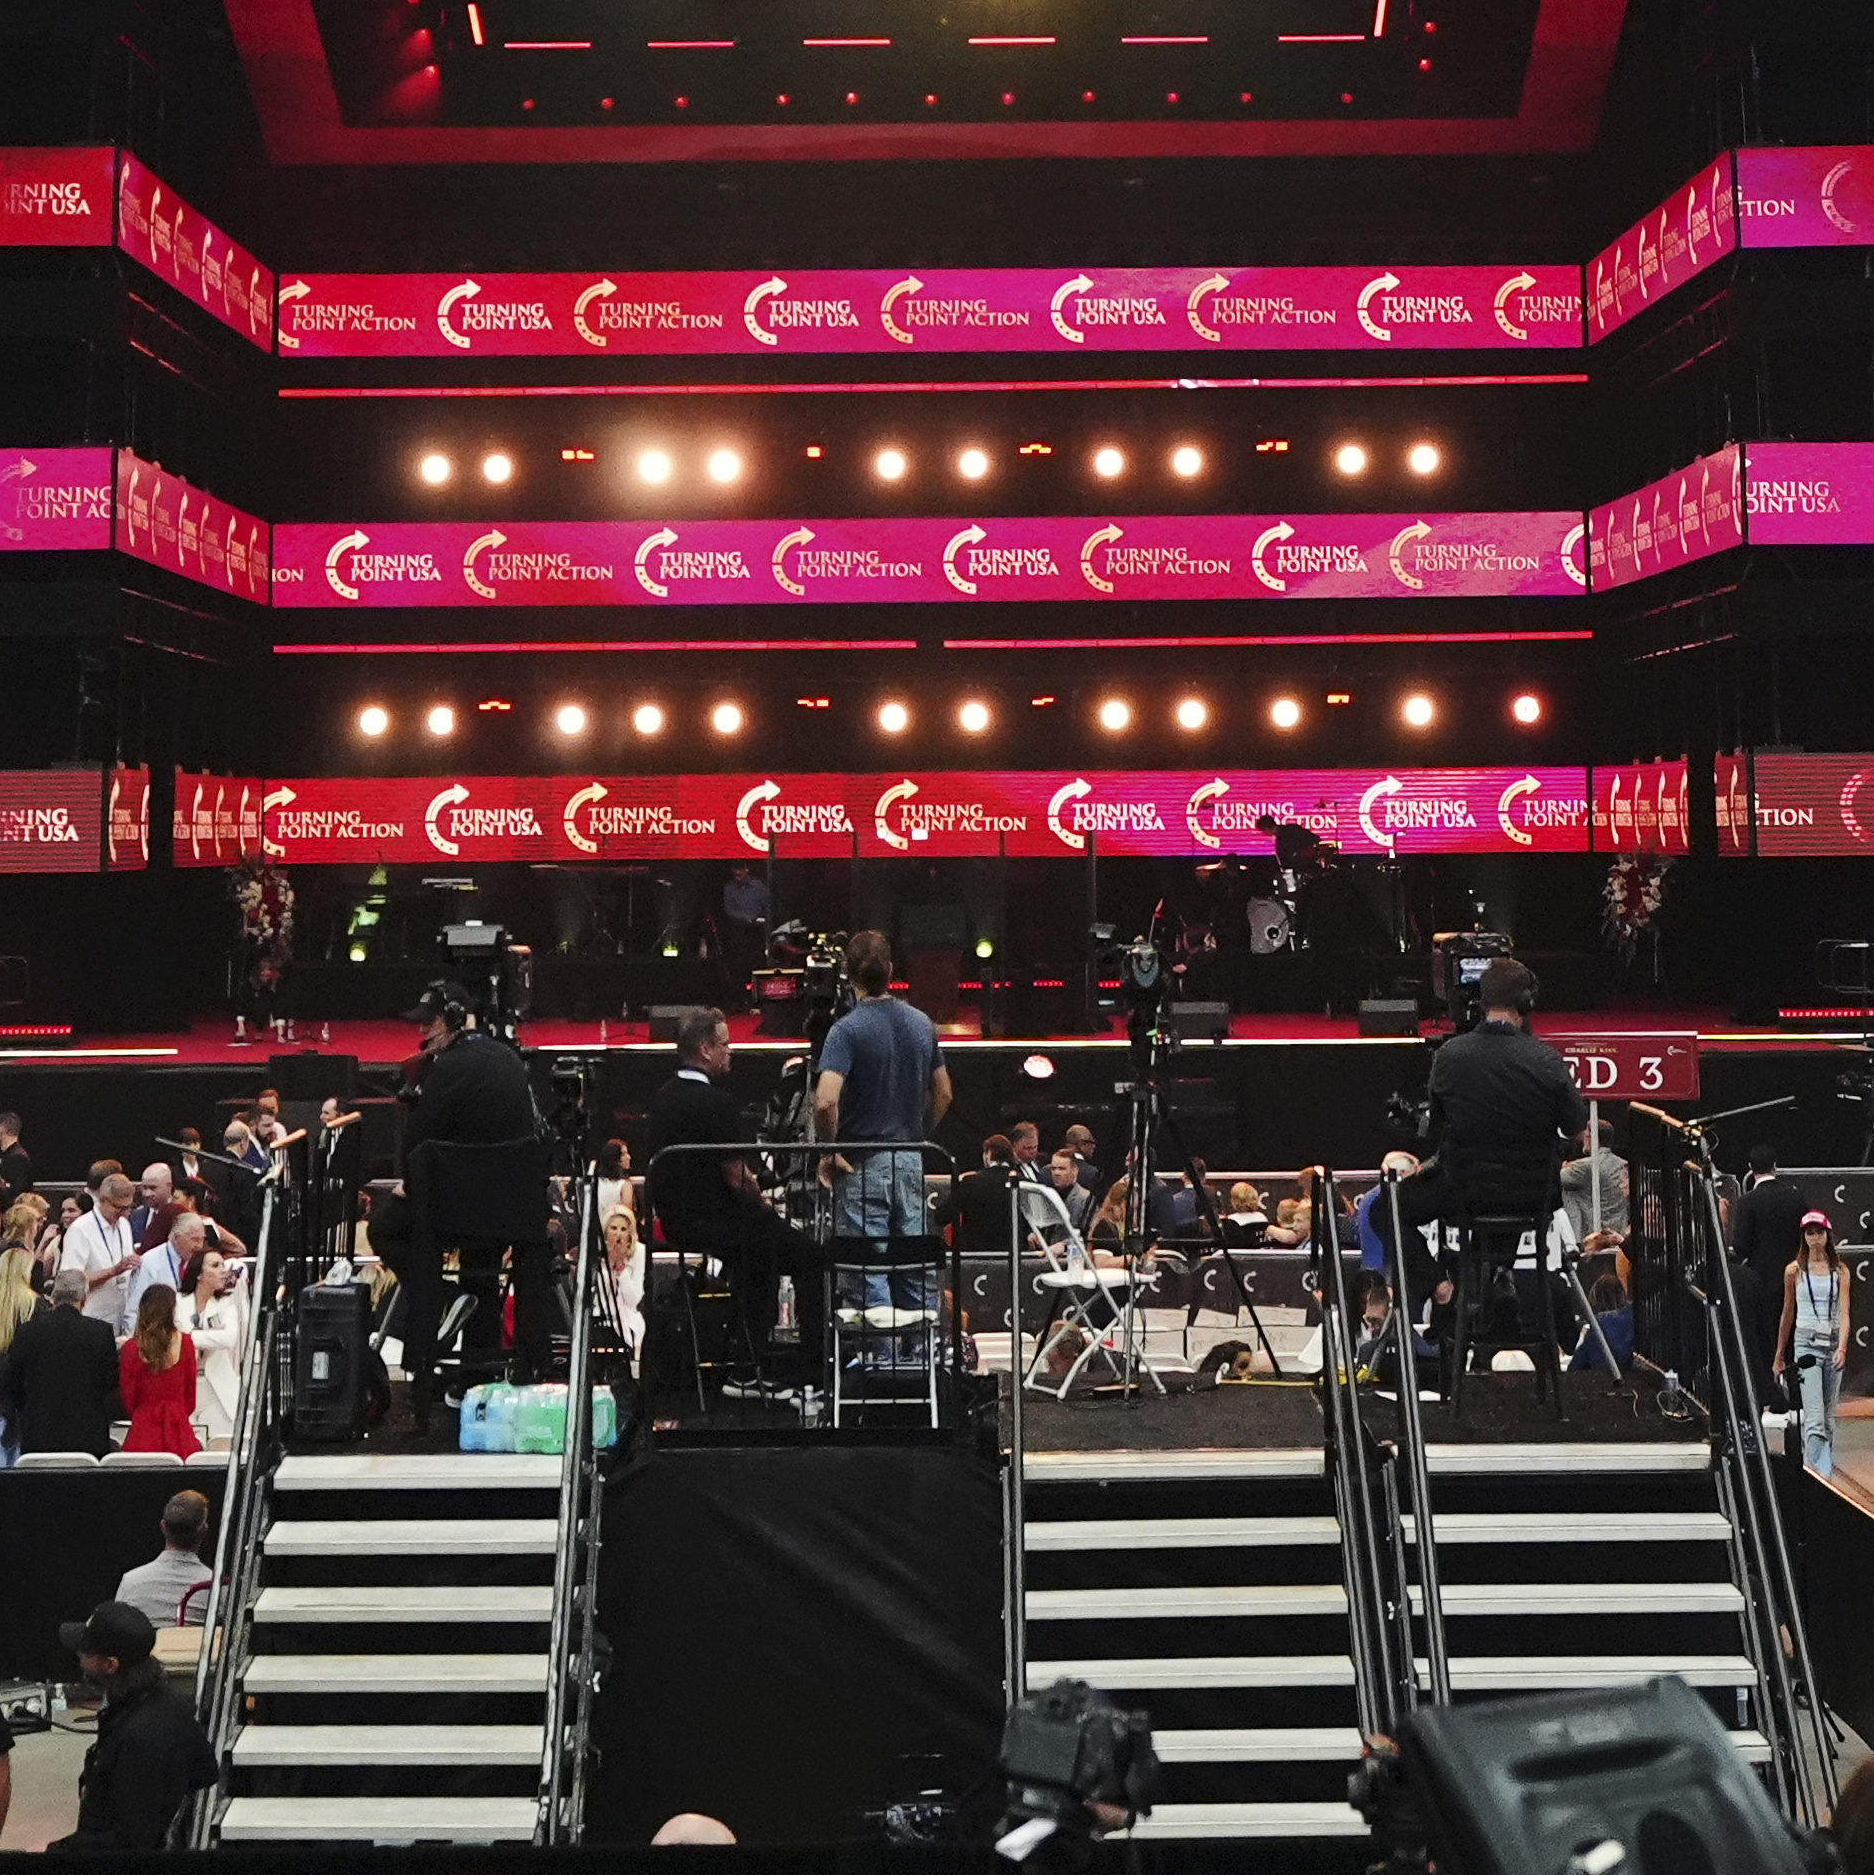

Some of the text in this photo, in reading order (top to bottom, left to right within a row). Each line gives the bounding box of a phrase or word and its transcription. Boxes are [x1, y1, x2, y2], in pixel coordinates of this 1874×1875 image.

[9, 183, 81, 199] RNING
[51, 199, 92, 216] USA
[1739, 200, 1795, 217] TION
[599, 302, 681, 316] TURNING
[769, 300, 850, 313] TURNING
[905, 299, 987, 313] TURNING
[1075, 298, 1157, 311] TURNING
[1213, 298, 1293, 311] TURNING
[1382, 296, 1464, 309] TURNING
[1517, 296, 1582, 309] TURNIN
[292, 304, 374, 318] TURNING
[462, 303, 544, 317] TURNING
[1213, 310, 1336, 324] POINT ACTION
[1382, 309, 1472, 323] POINT USA
[1519, 309, 1573, 322] POINT
[292, 316, 416, 331] POINT ACTION
[462, 316, 553, 330] POINT USA
[599, 315, 722, 328] POINT ACTION
[769, 313, 859, 327] POINT USA
[906, 312, 1029, 326] POINT ACTION
[1075, 311, 1166, 325] POINT USA
[1746, 481, 1830, 497] URNING
[15, 503, 83, 519] POINT
[1747, 497, 1798, 514] OINT
[1802, 497, 1842, 513] USA
[968, 550, 1050, 563] TURNING
[1105, 548, 1187, 561] TURNING
[1277, 546, 1359, 560] TURNING
[1414, 544, 1497, 557] TURNING
[350, 555, 433, 568] TURNING
[488, 554, 570, 567] TURNING
[660, 552, 742, 565] TURNING
[797, 551, 879, 565] TURNING
[1415, 556, 1539, 571] POINT ACTION
[660, 564, 750, 578] POINT USA
[798, 564, 921, 578] POINT ACTION
[968, 562, 1059, 576] POINT USA
[1106, 560, 1230, 575] POINT ACTION
[1277, 558, 1368, 573] POINT USA
[272, 568, 304, 582] ION
[351, 567, 442, 582] POINT USA
[488, 566, 613, 580] POINT ACTION
[761, 806, 844, 819] TURNING
[899, 805, 983, 817] TURNING
[1072, 803, 1156, 817] TURNING
[1213, 802, 1295, 816] TURNING
[1384, 801, 1467, 814] TURNING
[1522, 800, 1588, 813] TURNIN
[277, 811, 360, 825] TURNING
[450, 809, 533, 823] TURNING
[588, 807, 672, 821] TURNING
[1385, 813, 1477, 828] POINT USA
[1524, 812, 1579, 827] POINT
[1758, 808, 1814, 826] TION
[451, 821, 542, 836] POINT USA
[589, 820, 715, 834] POINT ACTION
[762, 818, 854, 833] POINT USA
[900, 817, 1026, 831] POINT ACTION
[1073, 816, 1165, 830] POINT USA
[1212, 815, 1259, 830] POIN
[38, 825, 80, 842] USA
[278, 824, 404, 838] POINT ACTION
[1563, 1057, 1664, 1091] ED 3
